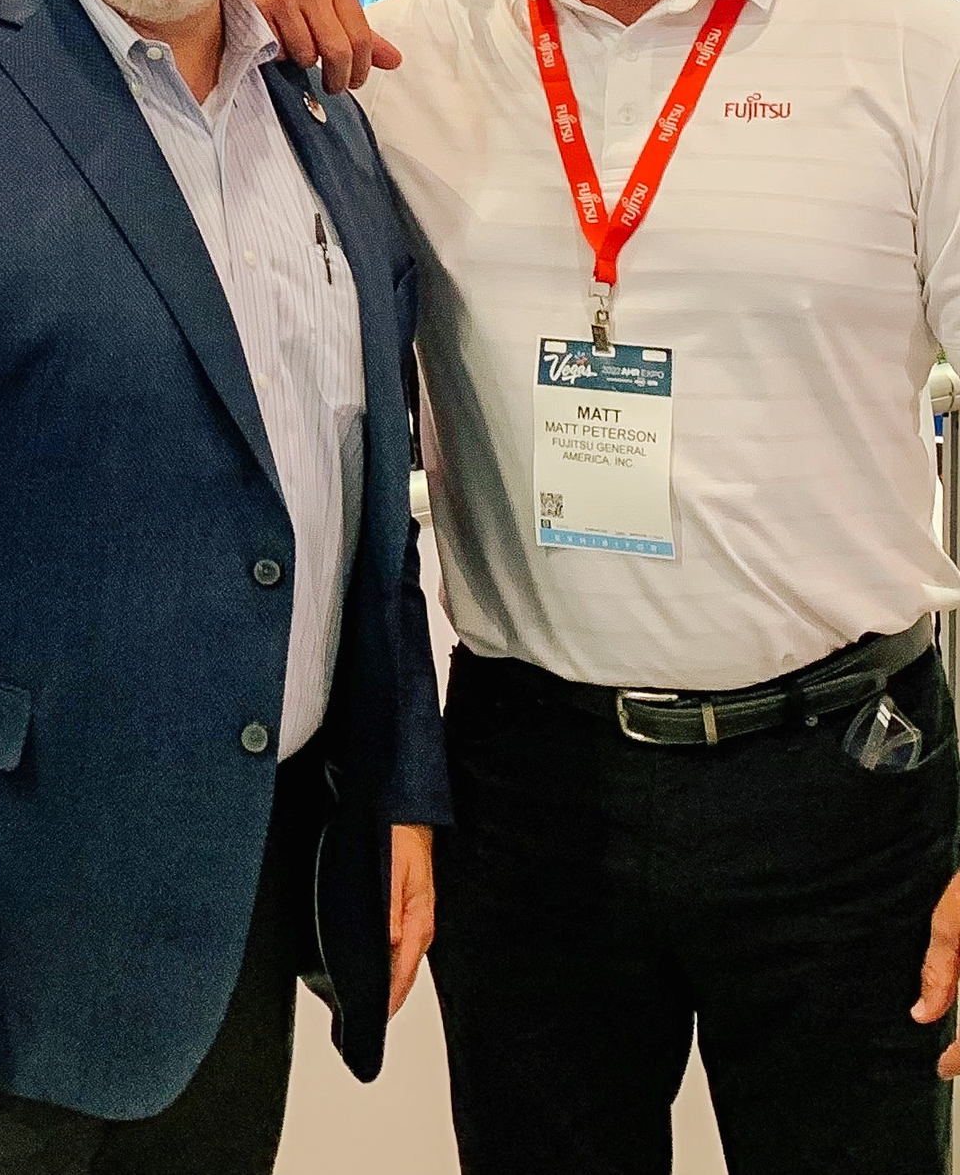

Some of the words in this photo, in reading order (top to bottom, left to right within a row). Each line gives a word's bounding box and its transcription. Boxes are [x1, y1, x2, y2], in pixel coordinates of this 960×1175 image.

[695, 27, 722, 67] FUJITSU
[555, 103, 577, 144] FUJITSU
[658, 103, 686, 143] FUJITSU
[724, 101, 791, 123] FUJITSU
[577, 182, 600, 224] FUJITSU
[620, 183, 649, 226] FUJITSU
[545, 420, 578, 436] MATT
[582, 424, 657, 443] PETERSON
[577, 405, 622, 423] MATT
[552, 436, 594, 451] FUJITSU
[596, 440, 647, 457] GENERAL
